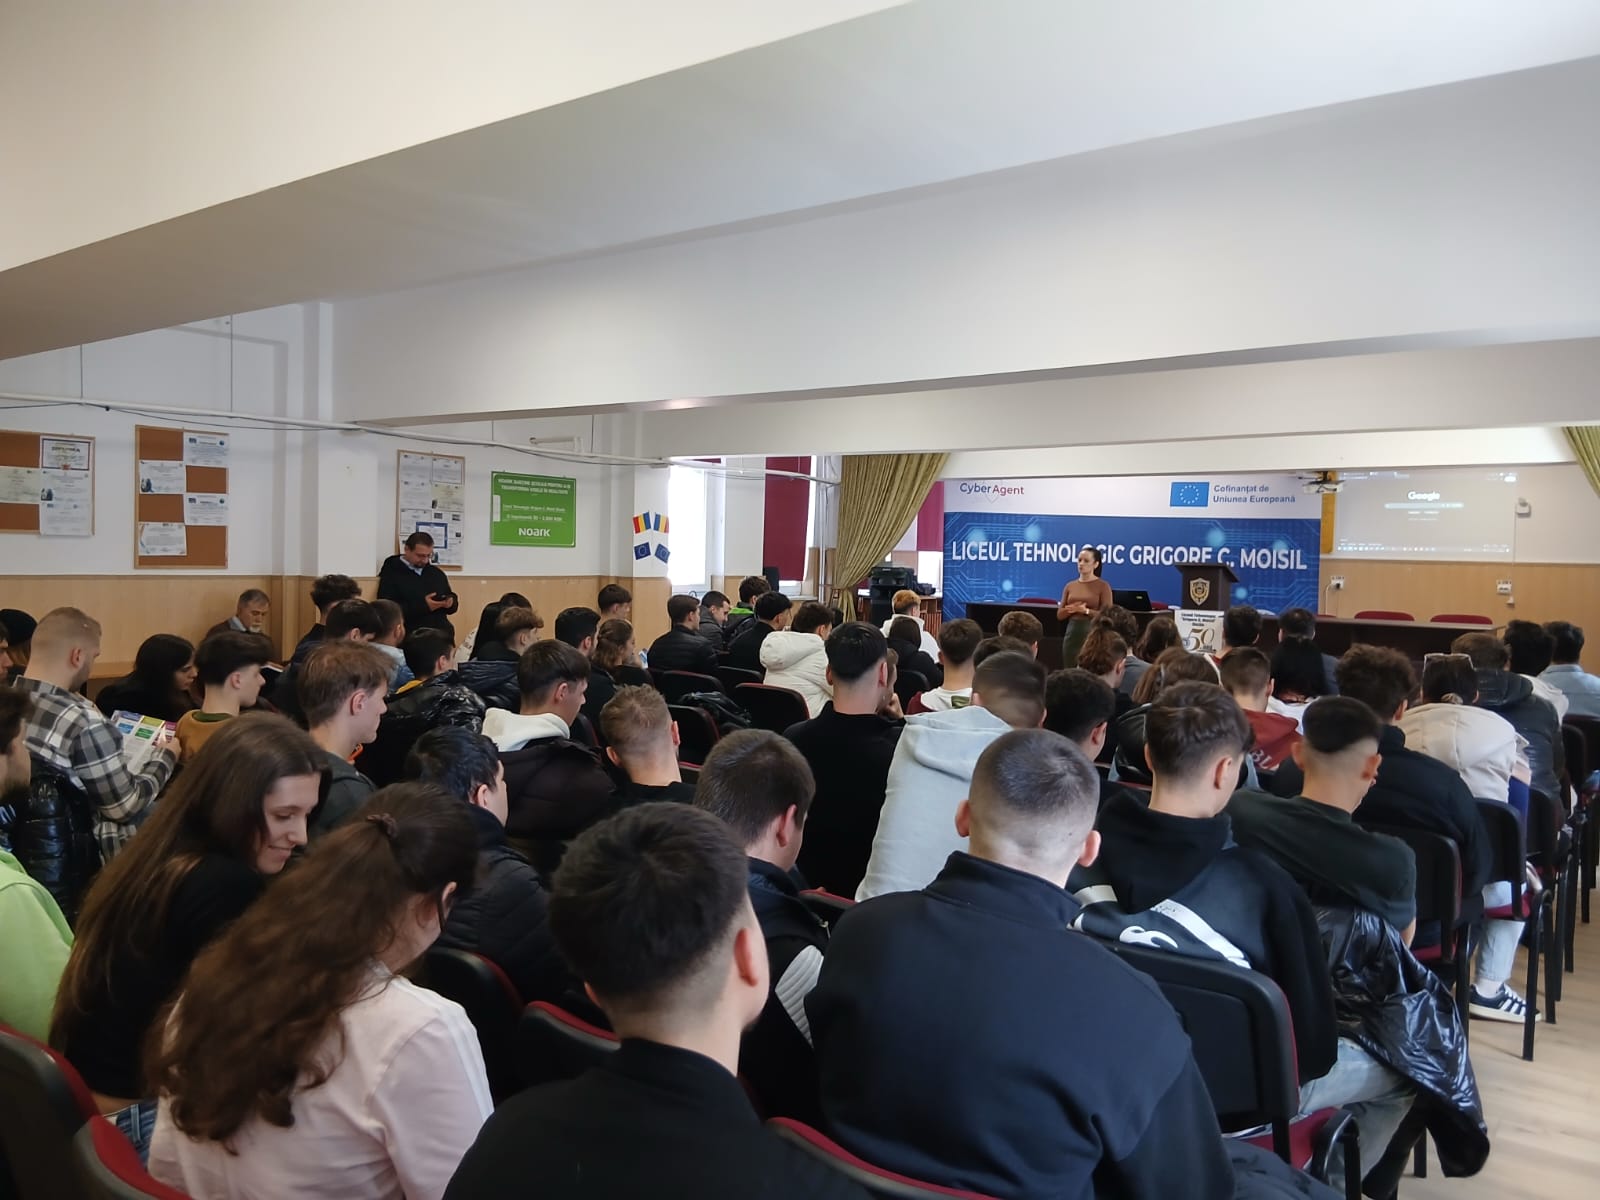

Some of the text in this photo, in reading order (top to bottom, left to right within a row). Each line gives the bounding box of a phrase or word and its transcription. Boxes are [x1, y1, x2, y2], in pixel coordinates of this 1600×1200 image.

[1259, 484, 1270, 492] de
[1213, 495, 1247, 503] Uniunea
[952, 541, 1010, 561] LICEUL
[1013, 543, 1125, 564] TEHNOLGIC
[1240, 549, 1308, 570] MOISIL
